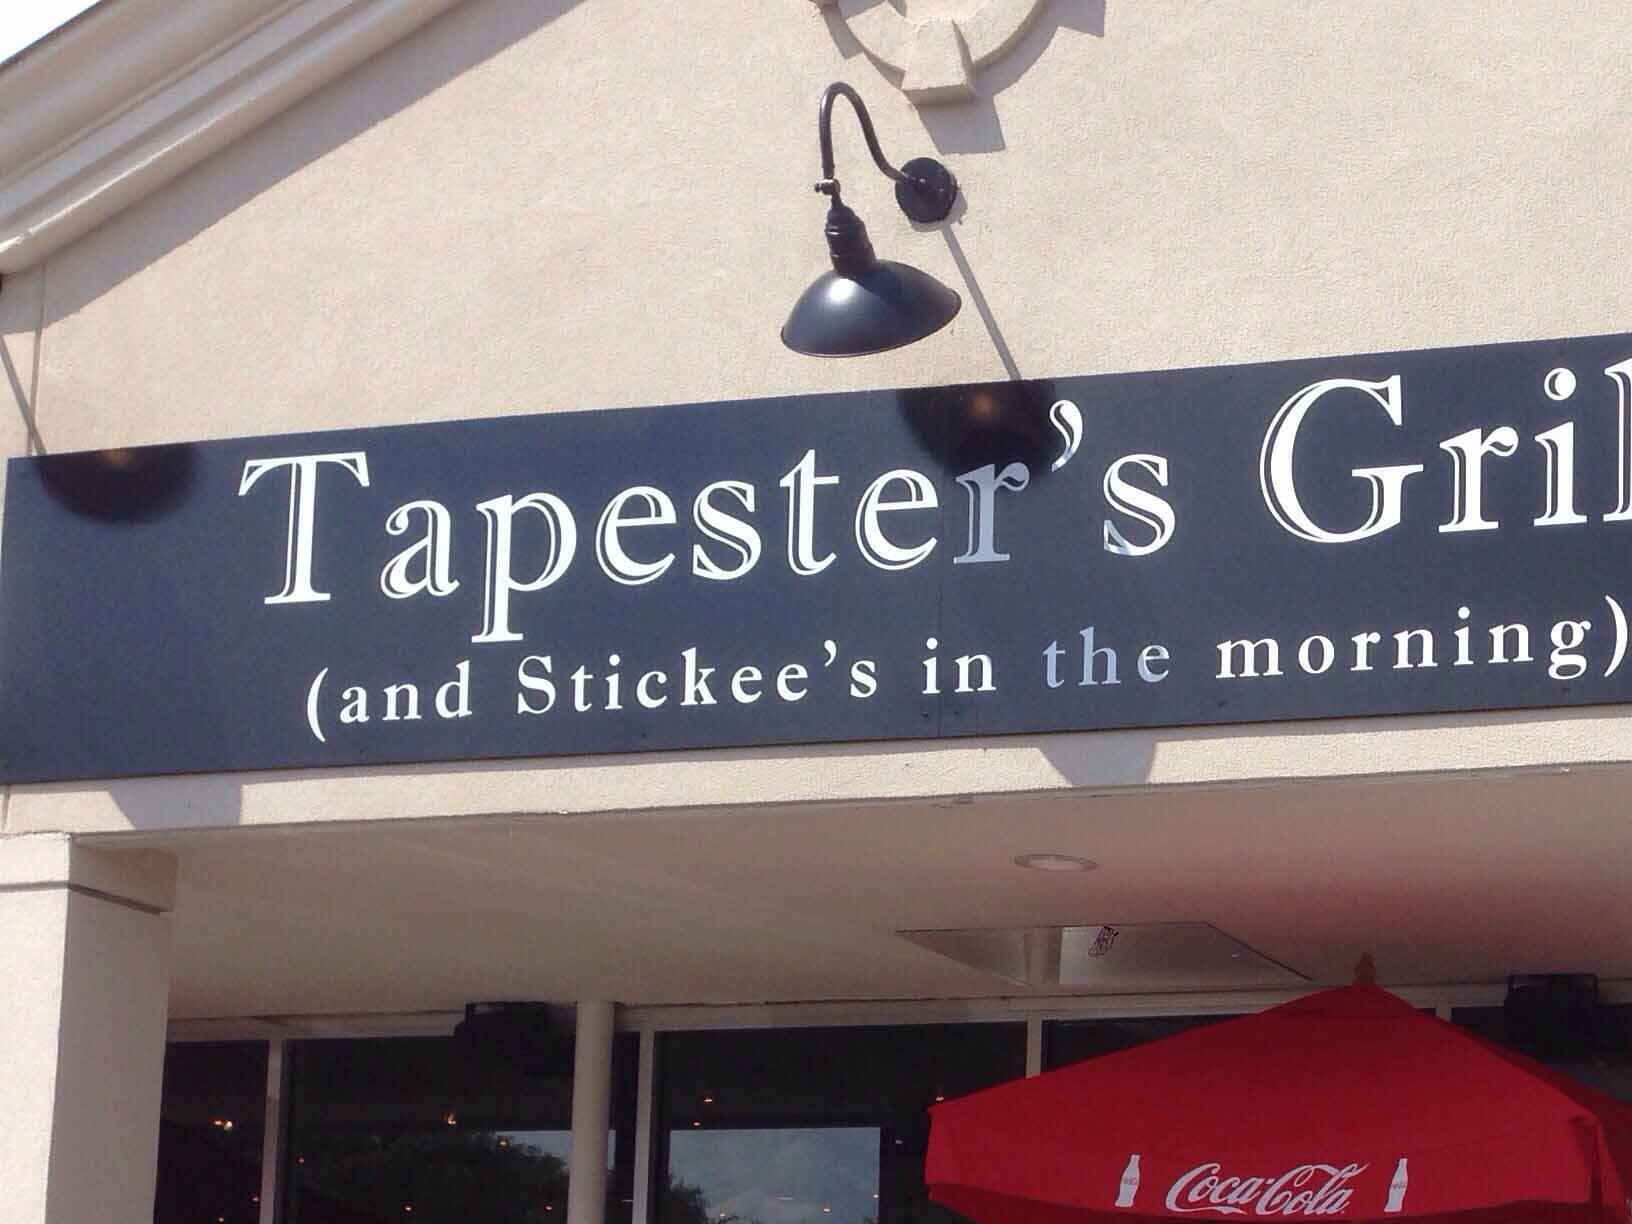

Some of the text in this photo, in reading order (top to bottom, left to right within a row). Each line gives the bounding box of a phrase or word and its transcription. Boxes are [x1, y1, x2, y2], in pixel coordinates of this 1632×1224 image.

[238, 400, 1176, 643] Tapester's
[306, 594, 1629, 742] (and Stickee's in the morning)
[1165, 1162, 1369, 1217] Coca-Cola
